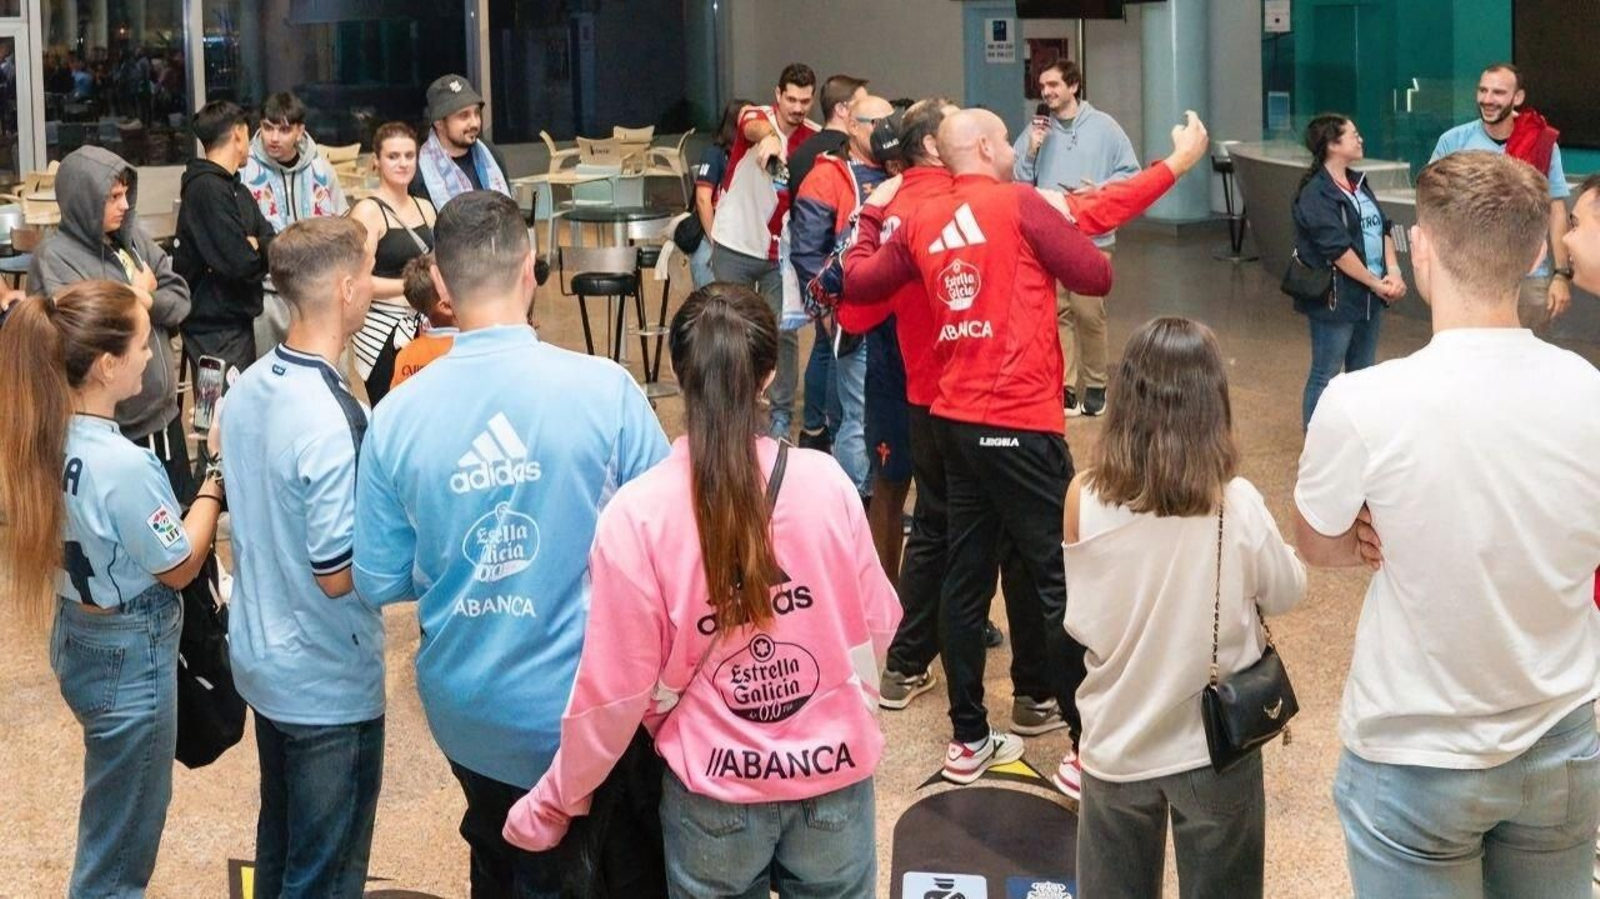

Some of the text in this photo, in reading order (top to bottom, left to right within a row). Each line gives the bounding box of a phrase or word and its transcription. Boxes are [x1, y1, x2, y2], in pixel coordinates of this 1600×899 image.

[450, 459, 542, 494] adidas
[453, 595, 537, 618] ABANCA
[697, 586, 814, 636] aas
[730, 658, 800, 685] Estrella
[733, 678, 800, 705] Galicia
